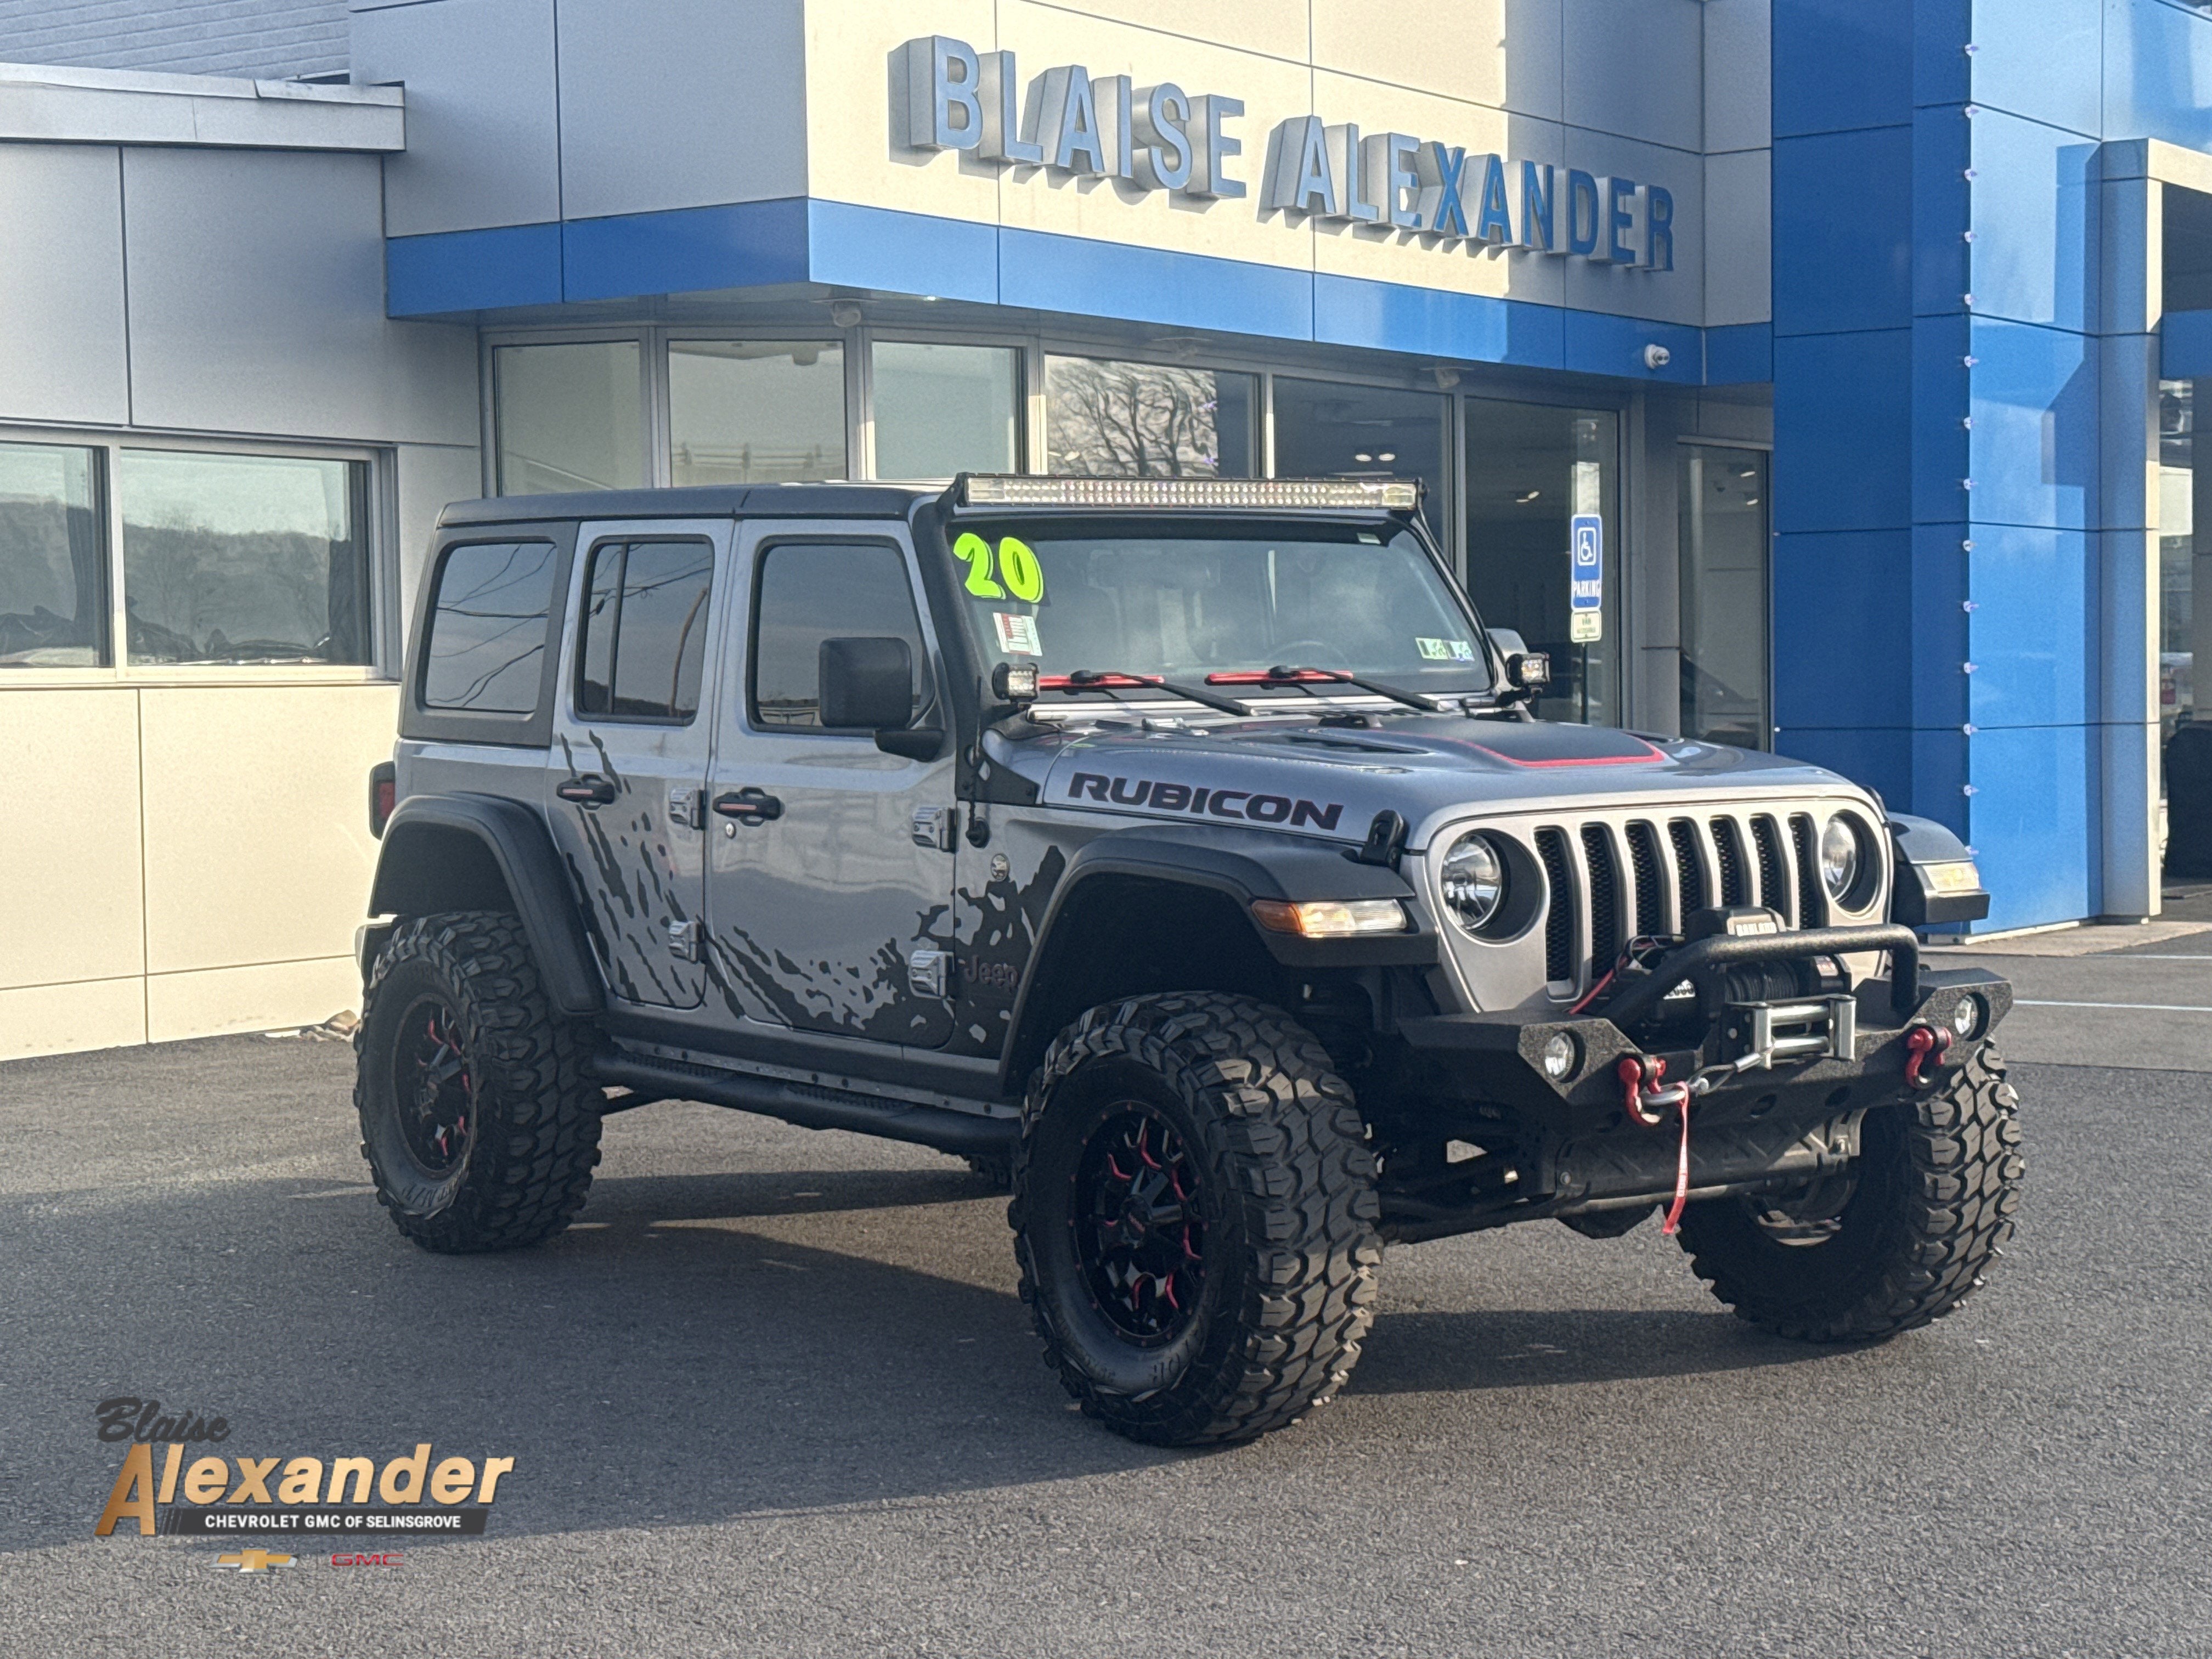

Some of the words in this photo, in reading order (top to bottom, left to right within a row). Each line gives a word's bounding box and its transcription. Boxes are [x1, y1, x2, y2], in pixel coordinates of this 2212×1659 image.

[889, 35, 1247, 200] BLAISE
[1267, 115, 1674, 272] ALEXANDER
[953, 532, 1043, 603] 20
[1573, 579, 1601, 597] PARKING
[1068, 772, 1344, 830] RUBICON
[963, 955, 1019, 996] Jeep
